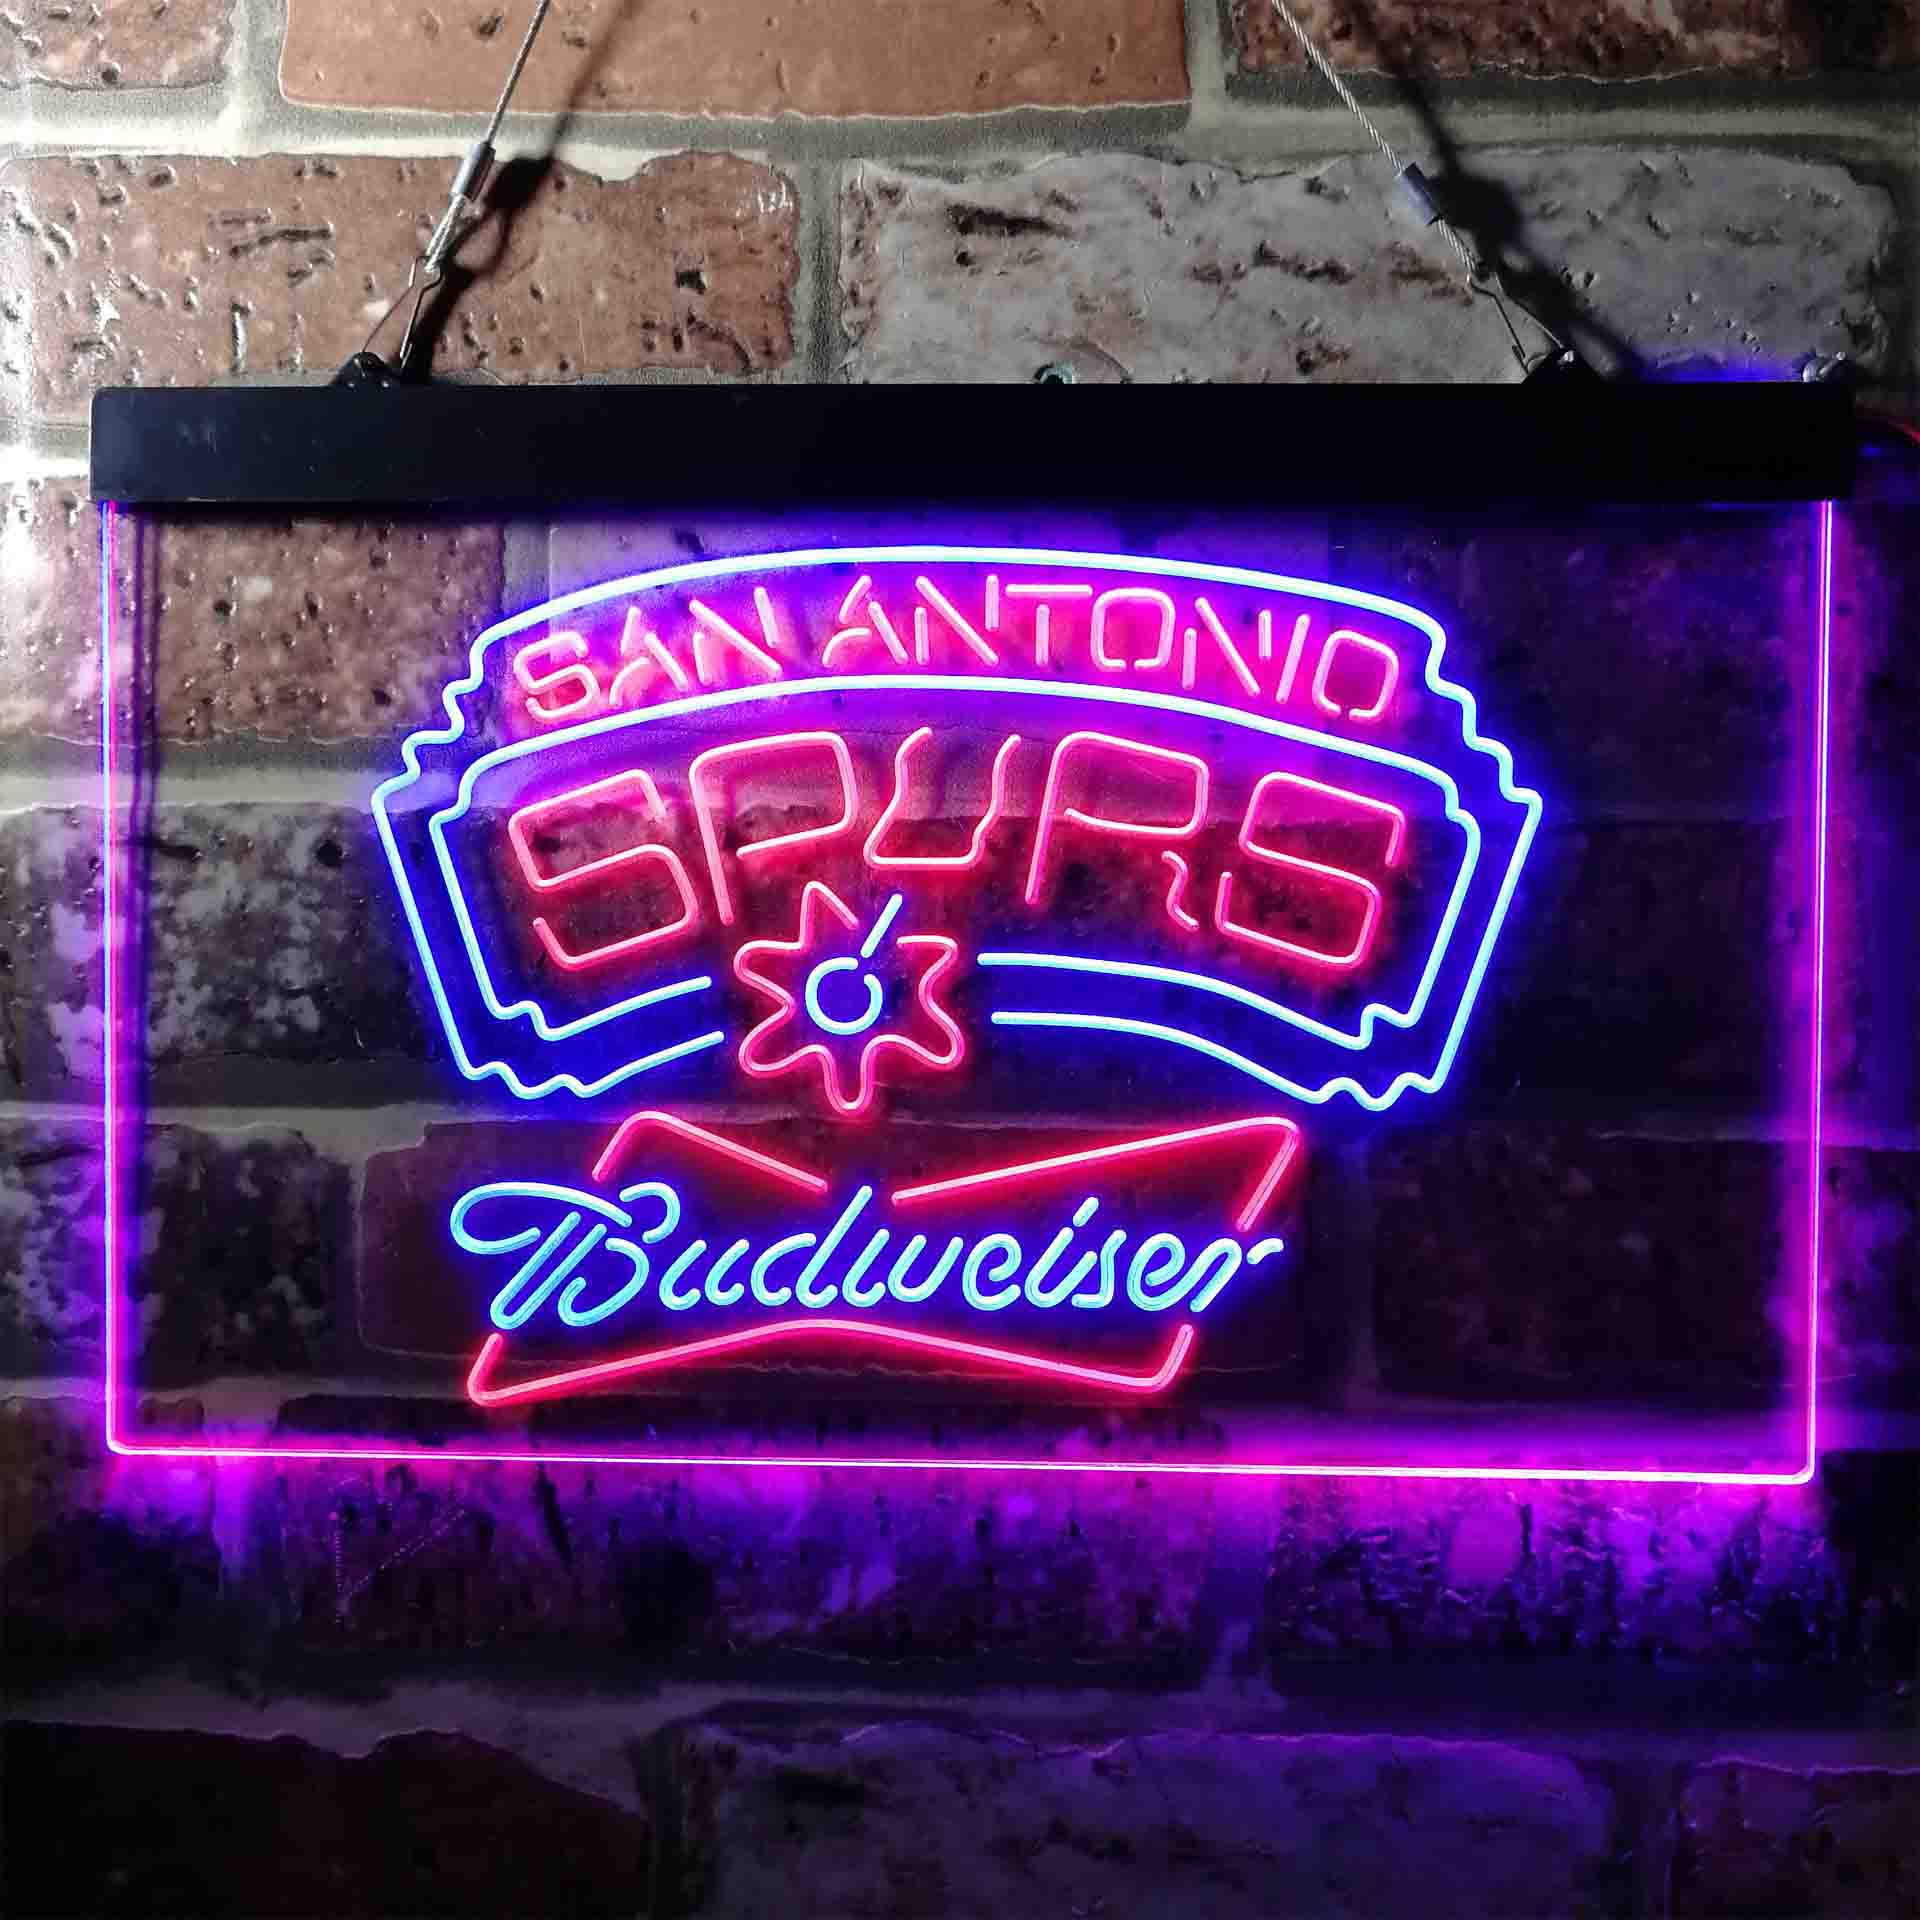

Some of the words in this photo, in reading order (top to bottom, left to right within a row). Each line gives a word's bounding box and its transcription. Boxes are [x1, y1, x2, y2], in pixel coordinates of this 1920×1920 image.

[513, 586, 783, 719] SAN
[822, 574, 1399, 720] ANTONIO
[508, 727, 1406, 970] SPURS
[450, 1181, 1284, 1331] Budweiser
